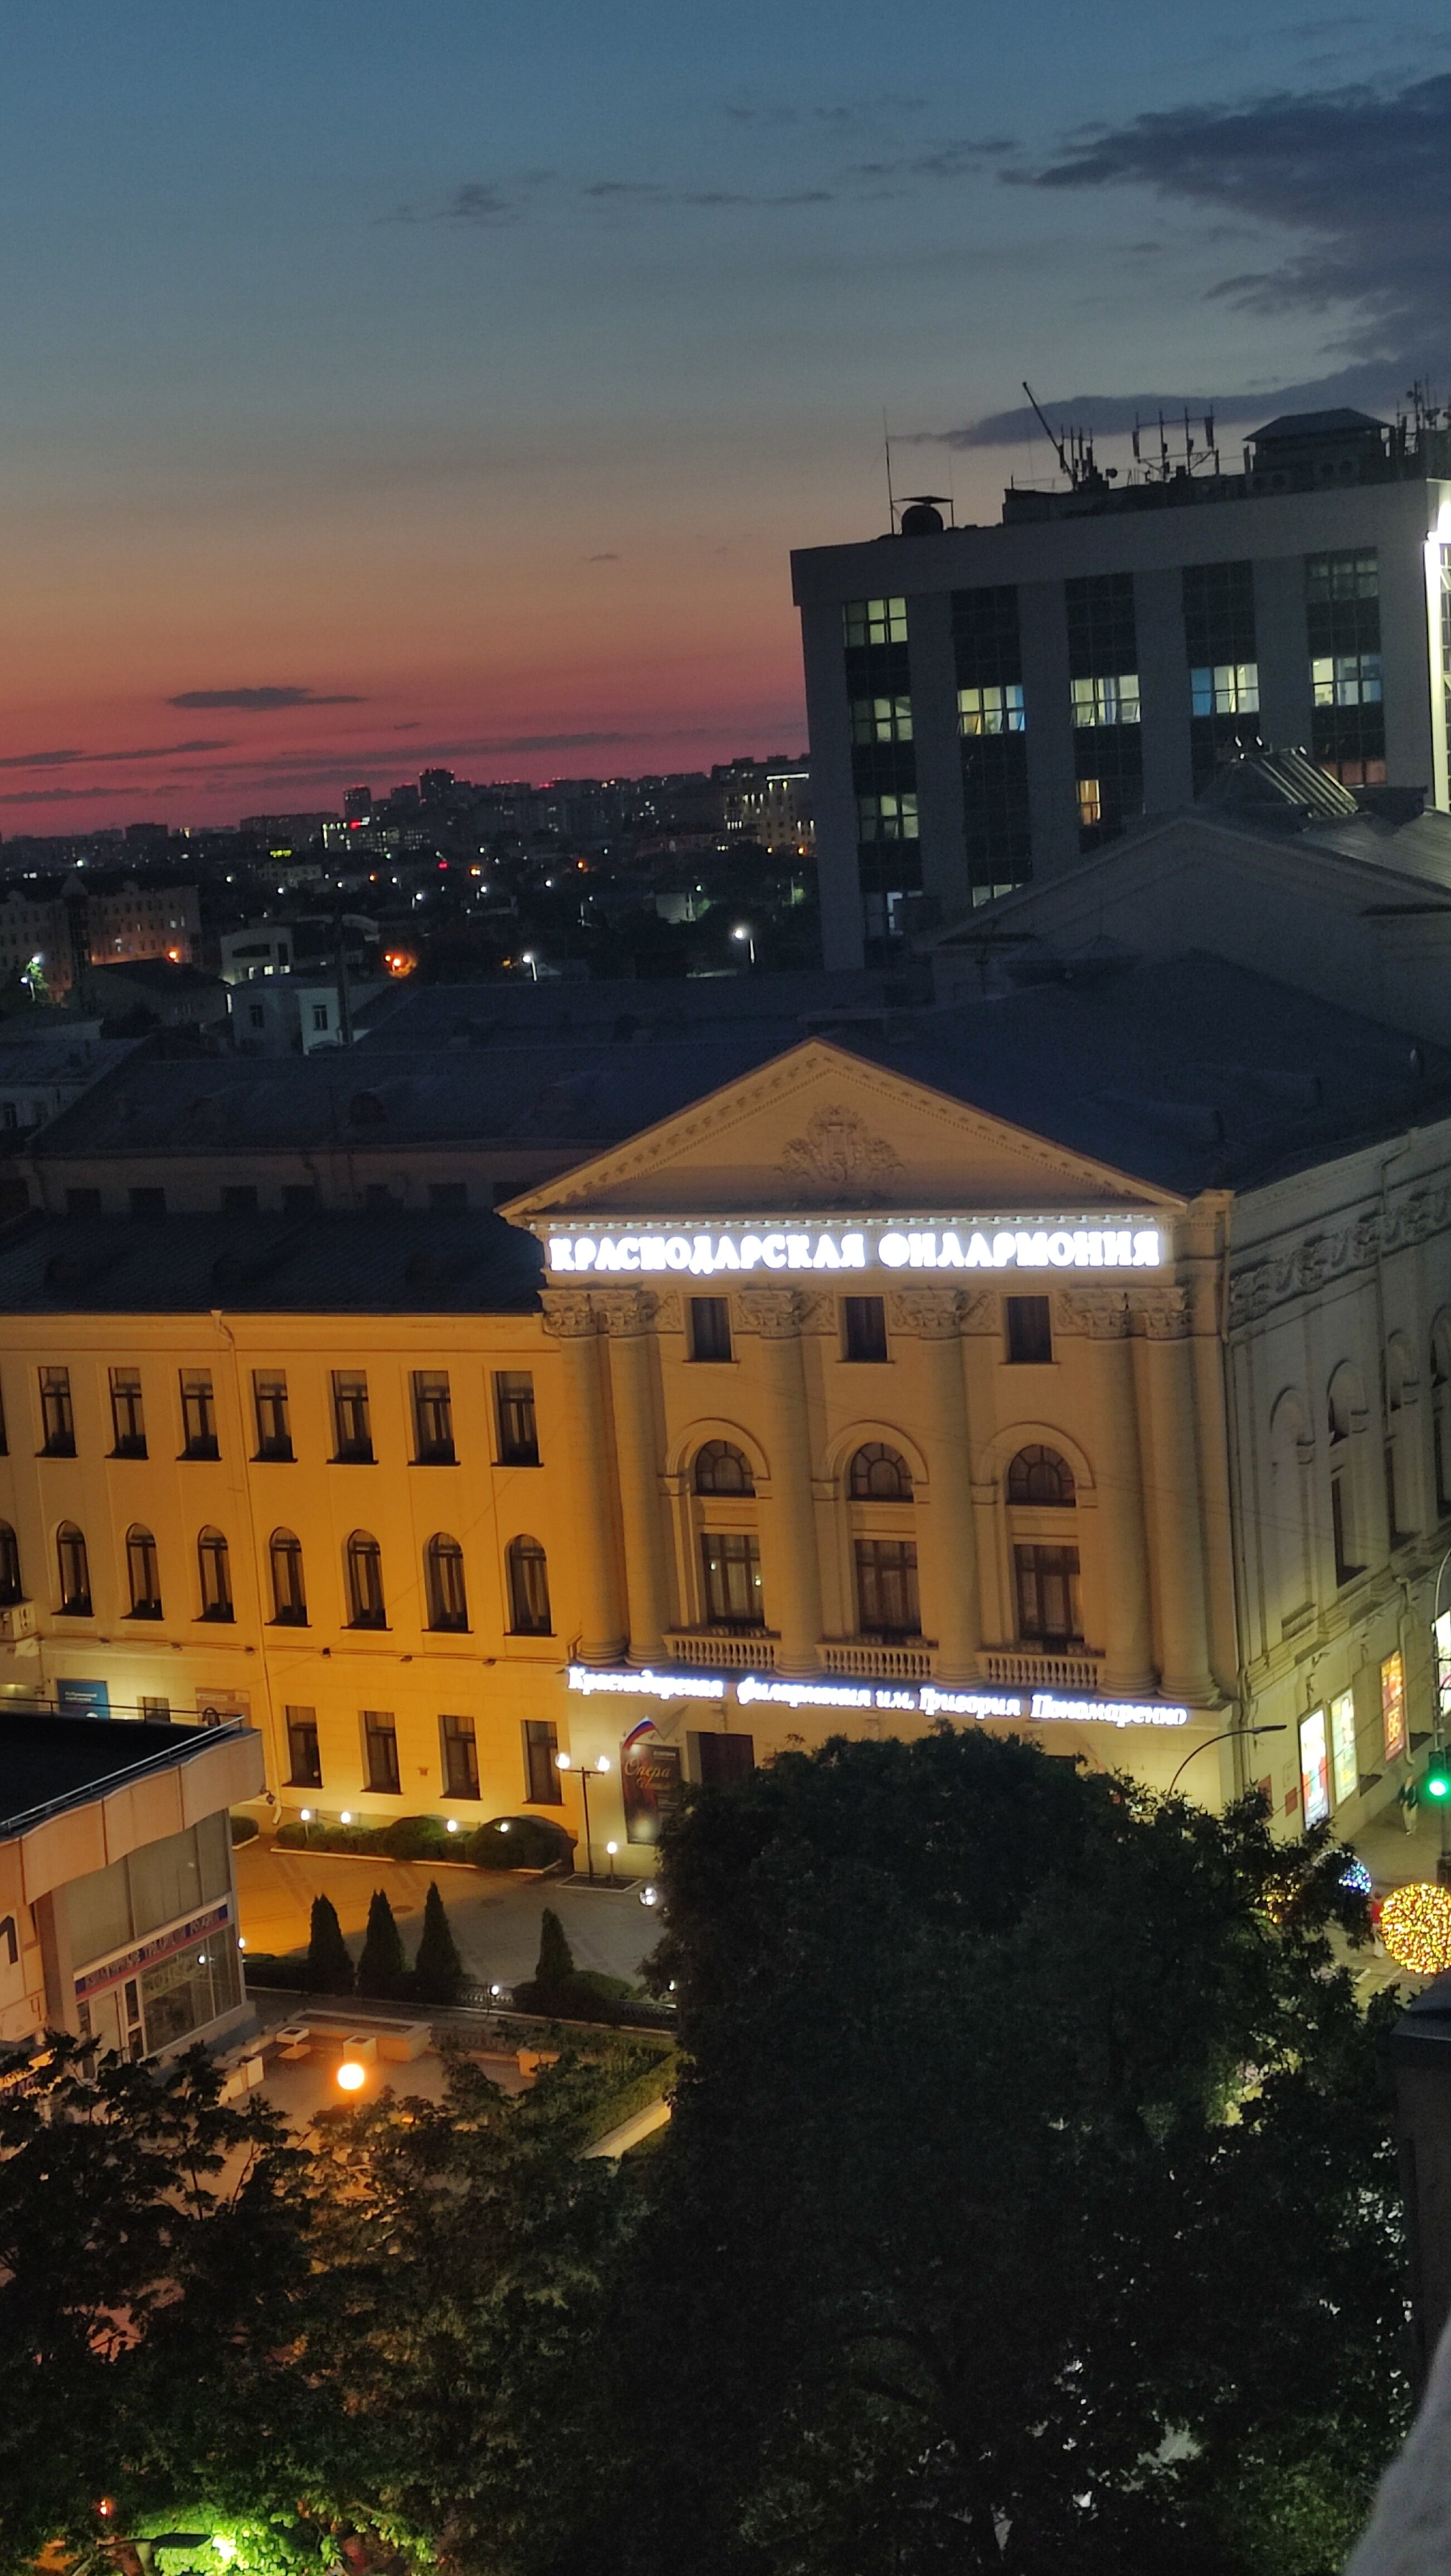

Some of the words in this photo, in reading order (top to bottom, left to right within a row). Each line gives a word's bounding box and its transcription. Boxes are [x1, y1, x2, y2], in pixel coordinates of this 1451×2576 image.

[549, 1233, 865, 1275] КРАСНОДАРСКАЯ
[878, 1231, 1160, 1267] ФИЛАРМОНИЯ
[568, 1667, 724, 1699] Краснодарская
[737, 1677, 871, 1708] филармония
[875, 1689, 915, 1710] им.
[919, 1688, 1021, 1720] Григория
[1030, 1694, 1188, 1728] Пономаренко
